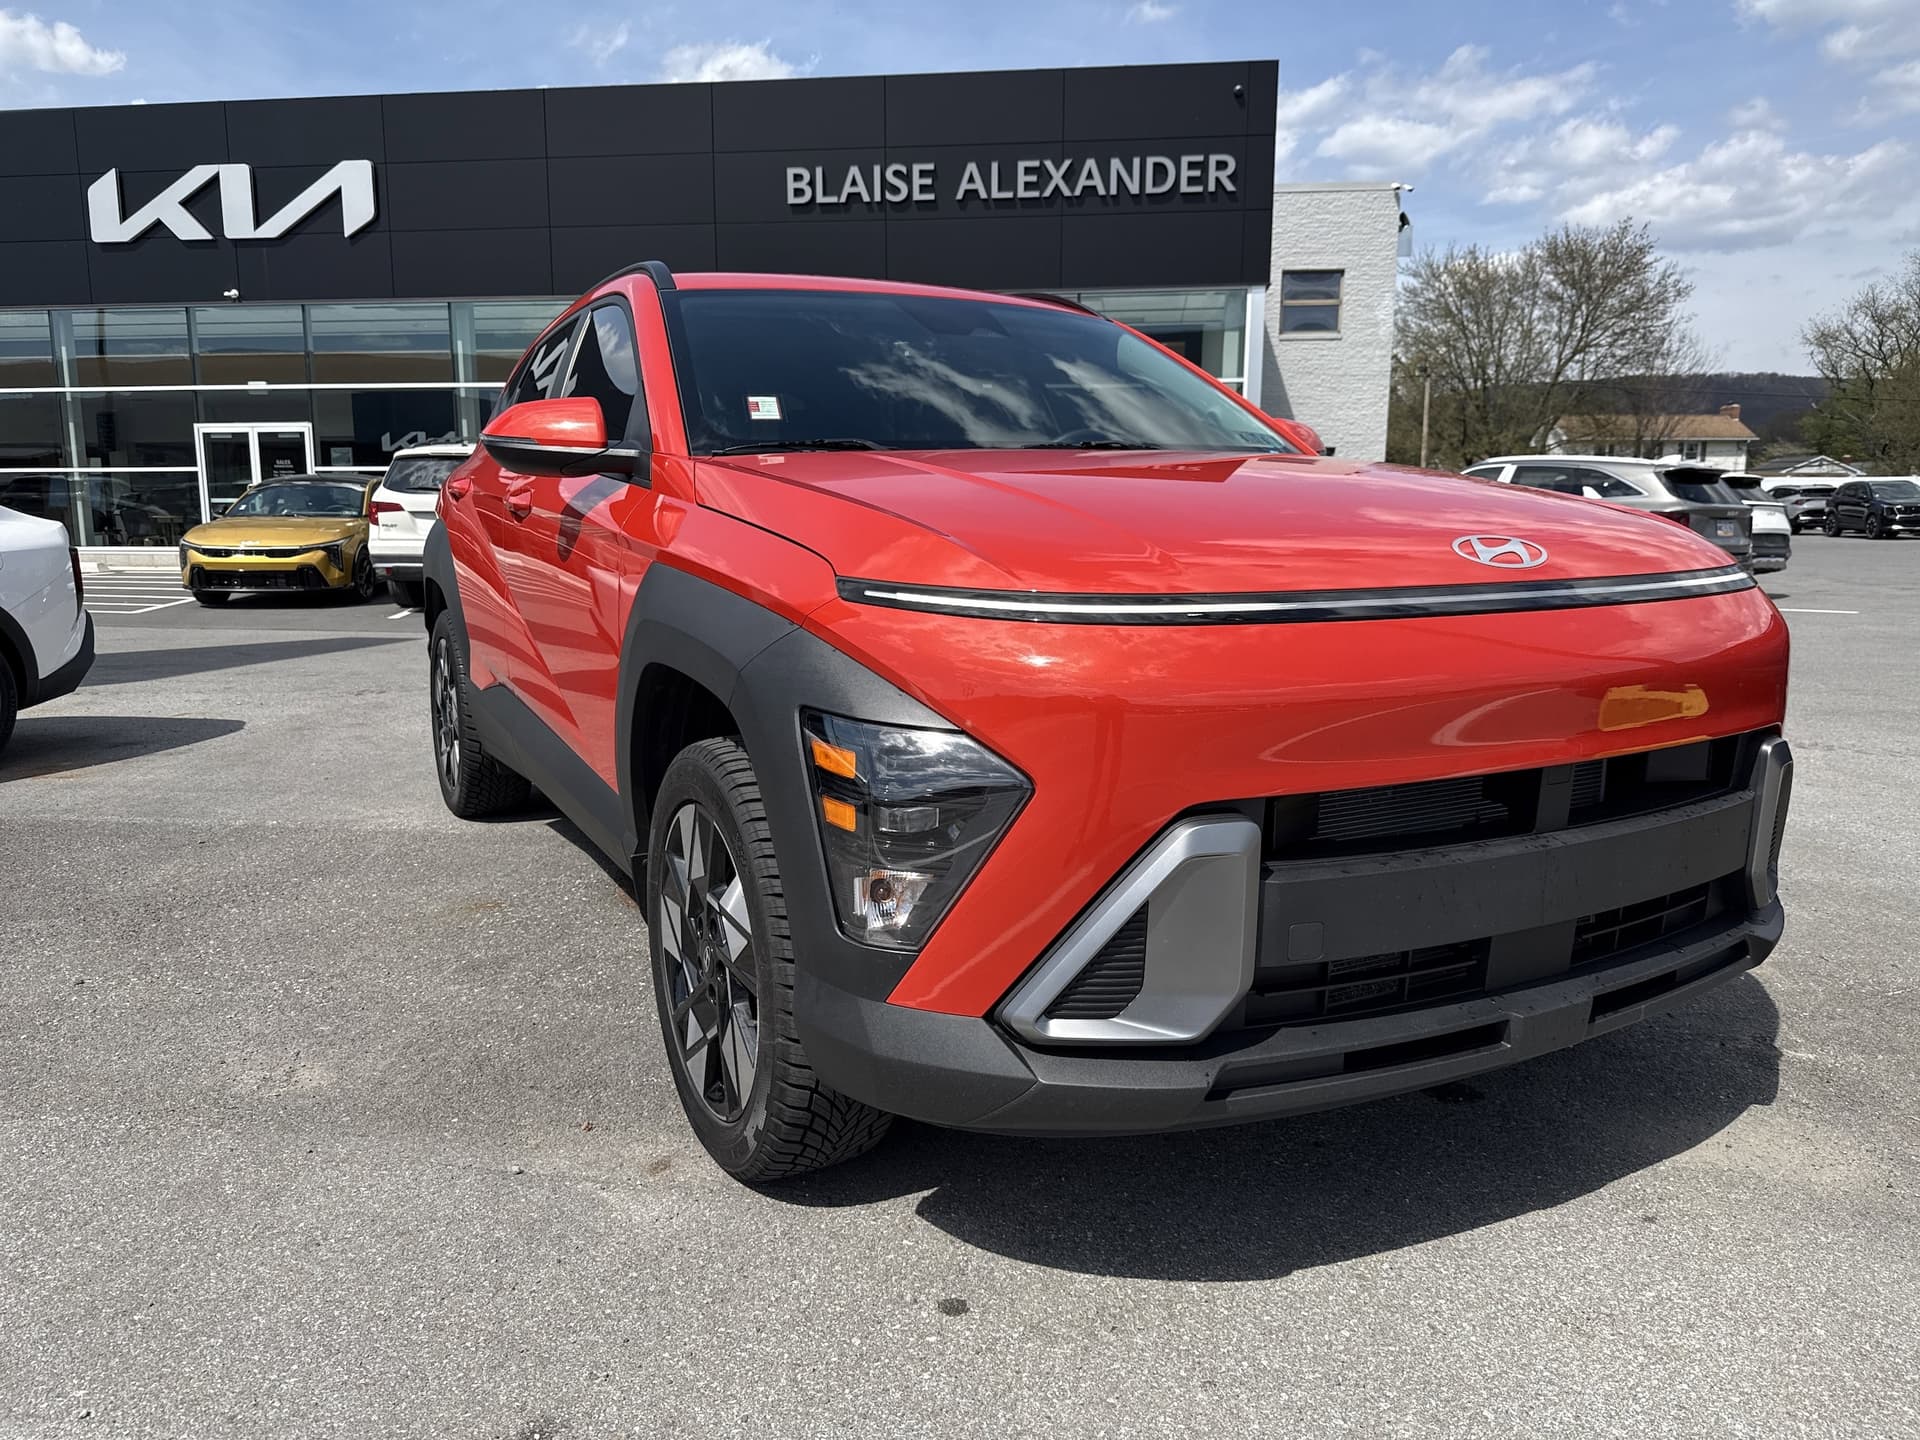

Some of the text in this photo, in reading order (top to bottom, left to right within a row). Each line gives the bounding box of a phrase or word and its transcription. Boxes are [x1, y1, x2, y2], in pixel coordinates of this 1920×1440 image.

[87, 159, 376, 243] KIA
[786, 154, 1237, 204] BLAISE ALEXANDER
